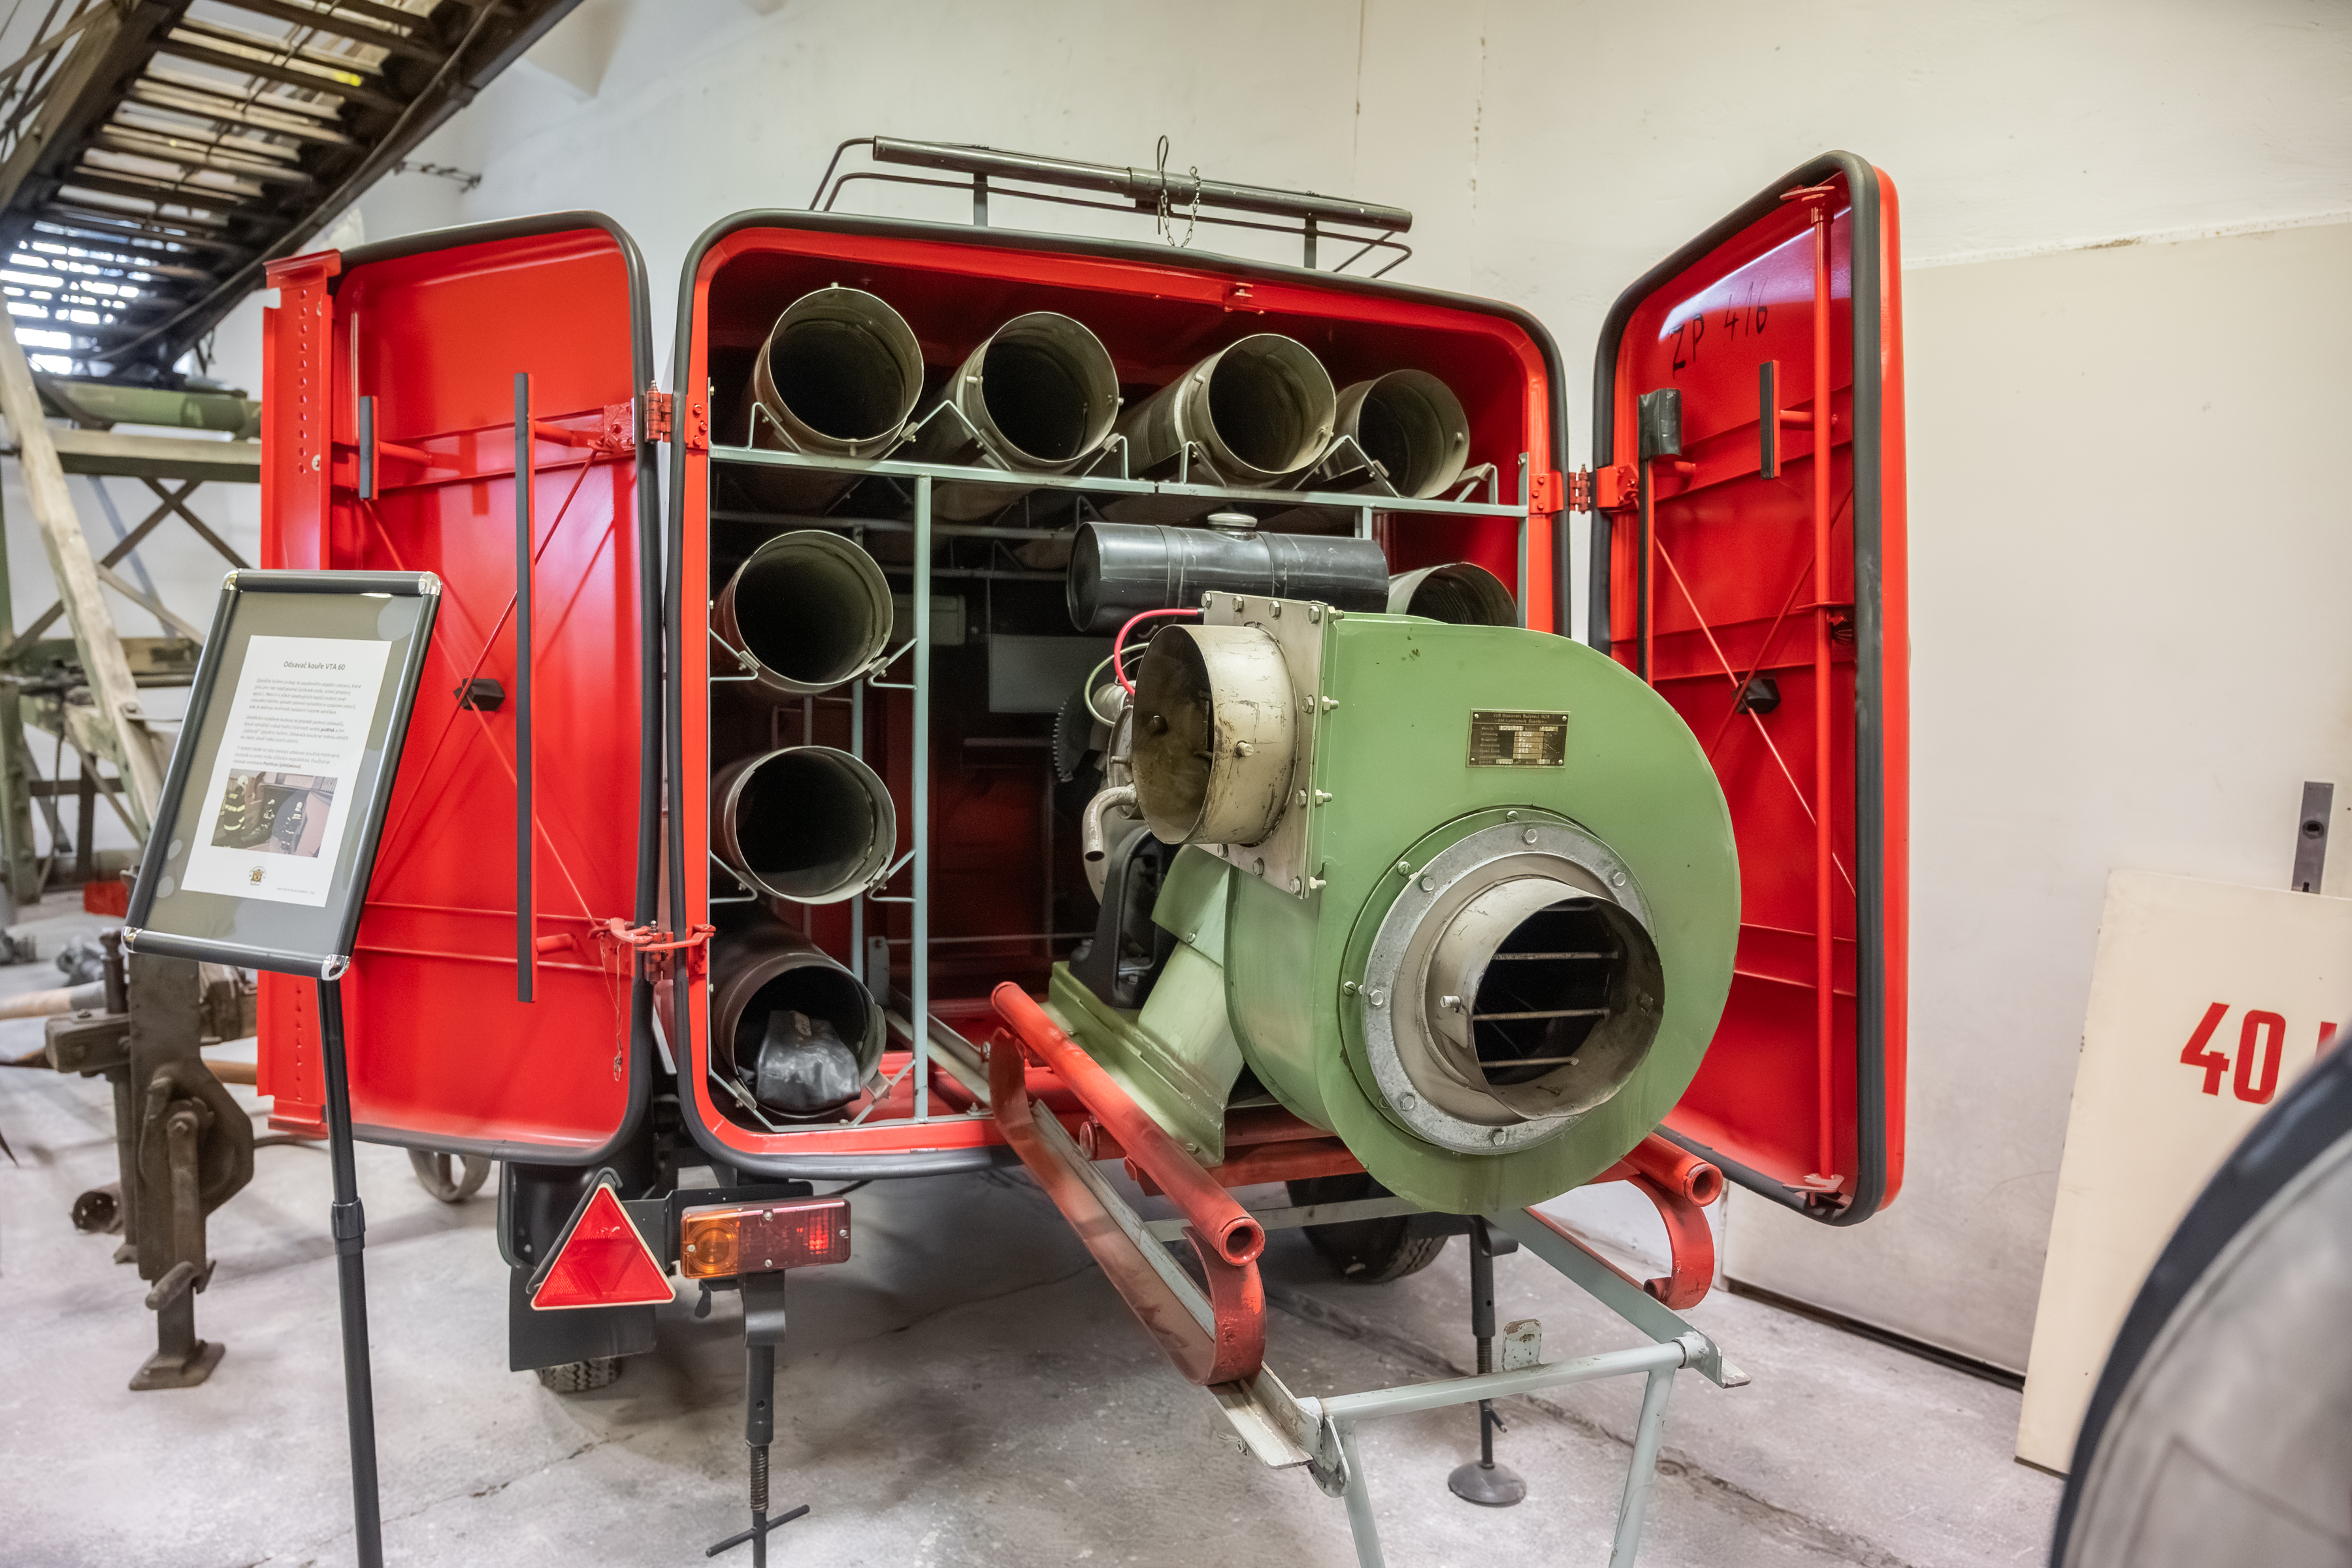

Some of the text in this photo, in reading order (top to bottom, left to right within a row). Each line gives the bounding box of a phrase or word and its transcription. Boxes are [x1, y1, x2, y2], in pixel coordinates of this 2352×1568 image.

[1669, 277, 1768, 380] ZP 416
[2180, 1002, 2287, 1105] 40
